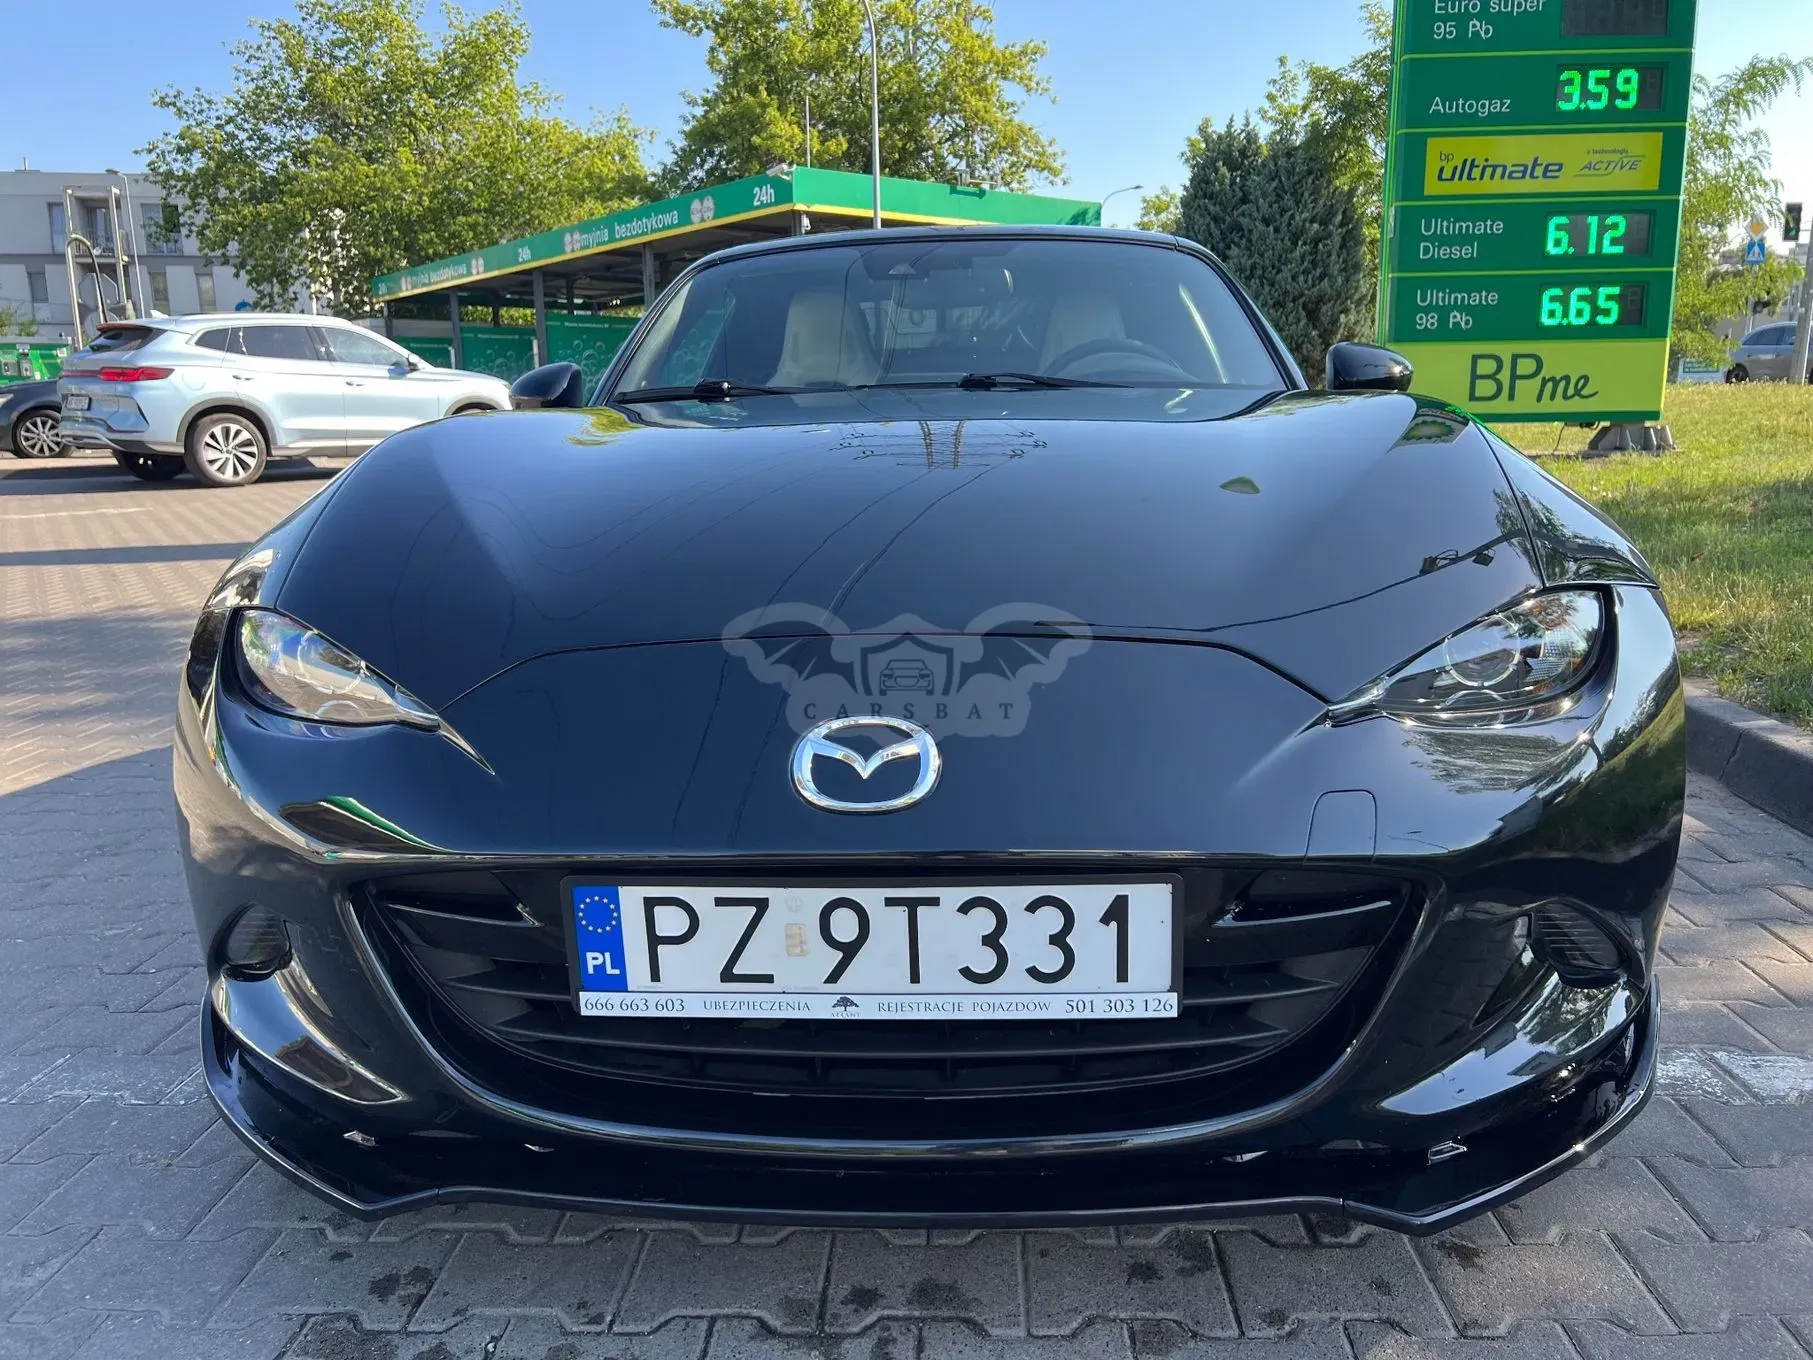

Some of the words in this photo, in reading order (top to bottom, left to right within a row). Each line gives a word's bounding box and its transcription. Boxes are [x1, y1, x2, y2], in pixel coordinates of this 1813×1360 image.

[1434, 0, 1481, 14] Euro
[1489, 0, 1546, 16] super
[1433, 21, 1456, 39] 95
[1557, 69, 1639, 111] 3.59
[1429, 96, 1511, 117] Autogaz
[1439, 150, 1454, 163] bp
[1579, 159, 1643, 172] ACTIVE
[1437, 156, 1563, 181] ultimate
[753, 184, 775, 206] 24h
[581, 226, 609, 248] myjnia
[614, 210, 679, 239] bezdotykowa
[1421, 218, 1504, 236] Ultimate
[1545, 215, 1627, 256] 6.12
[518, 245, 532, 262] 24h
[1419, 241, 1478, 260] Diesel
[1416, 288, 1499, 307] Ultimate
[1540, 287, 1621, 326] 6.65
[1416, 313, 1438, 330] 98
[643, 896, 775, 984] PZ
[818, 894, 1130, 985] 9T331
[586, 952, 620, 975] PL
[584, 998, 615, 1012] 666
[619, 998, 649, 1012] 663
[655, 998, 685, 1013] 603
[703, 999, 811, 1013] UBEZPIECZENIA
[877, 1001, 964, 1014] REJESTRACJE
[972, 999, 1051, 1014] POJAZDÓW
[1065, 998, 1096, 1014] 501
[1103, 998, 1136, 1014] 303
[1143, 998, 1174, 1013] 126
